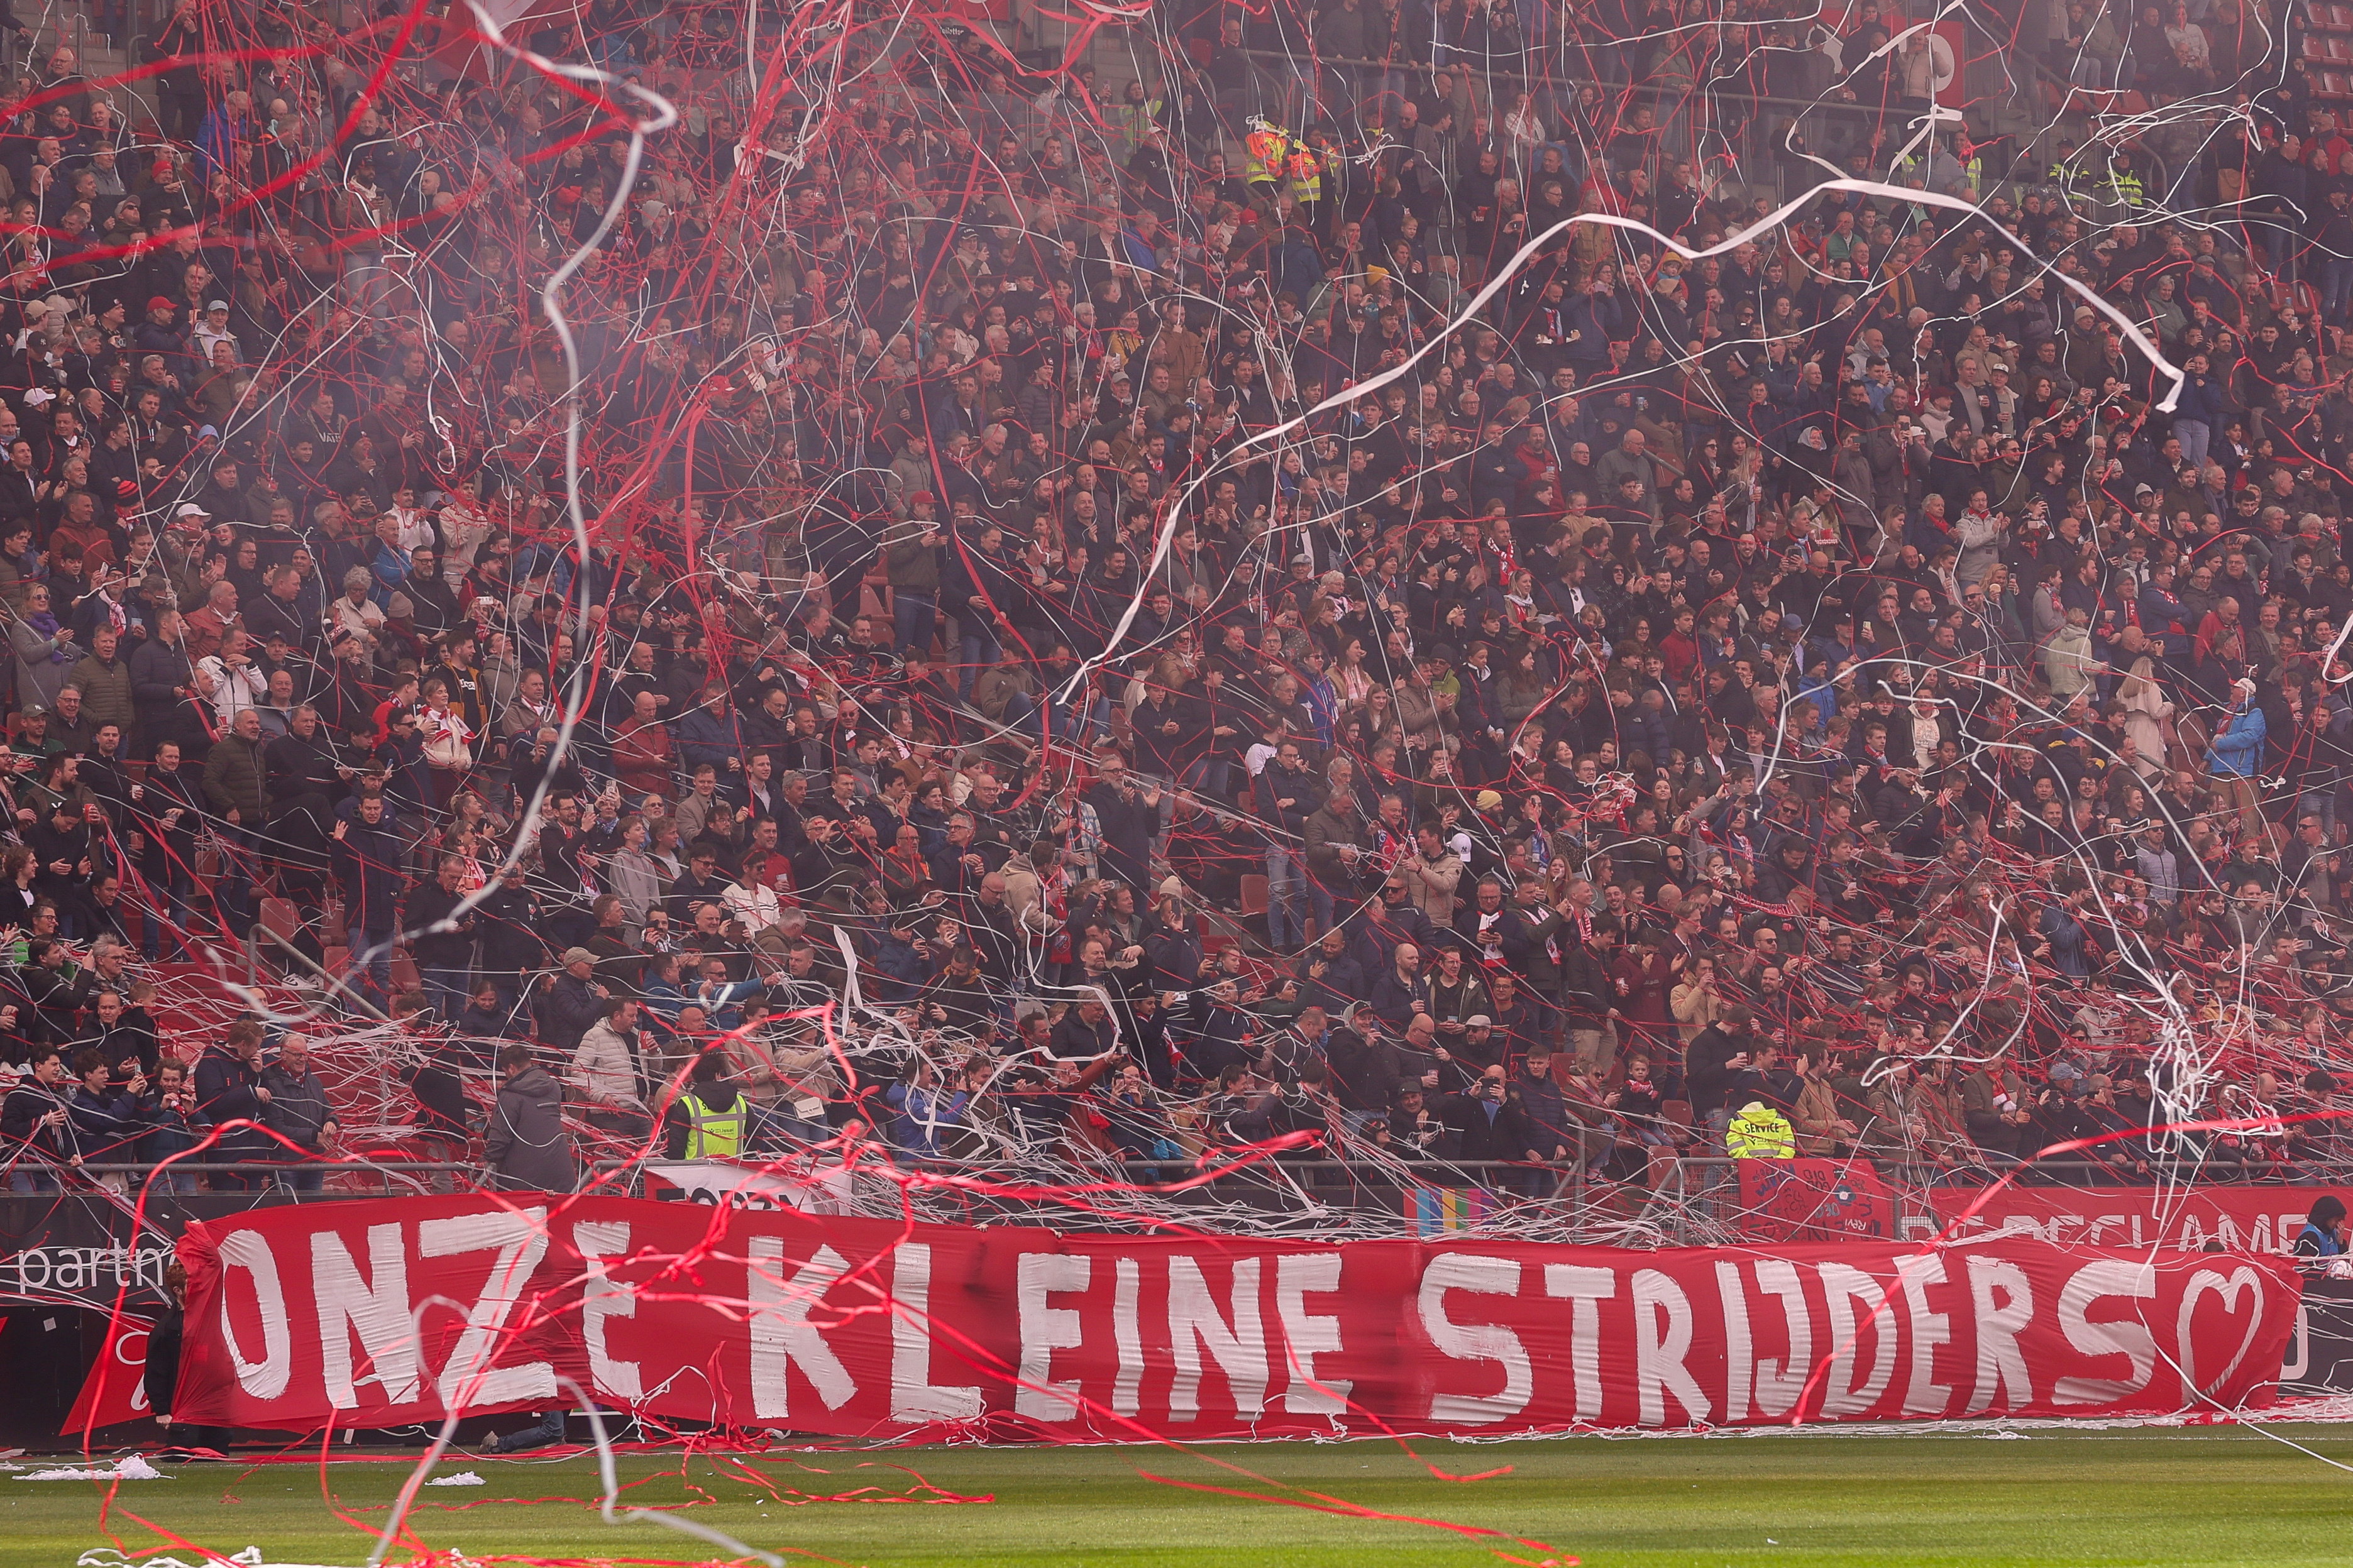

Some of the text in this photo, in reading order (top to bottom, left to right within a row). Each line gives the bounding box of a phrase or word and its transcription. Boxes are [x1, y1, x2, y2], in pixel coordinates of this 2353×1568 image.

[319, 432, 341, 443] VAN
[1744, 1123, 1779, 1133] SERVICE
[18, 1238, 174, 1294] partn
[218, 1205, 641, 1408] ONZE
[748, 1235, 1353, 1423] KLEINE
[1418, 1252, 2155, 1427] STRIJDERS
